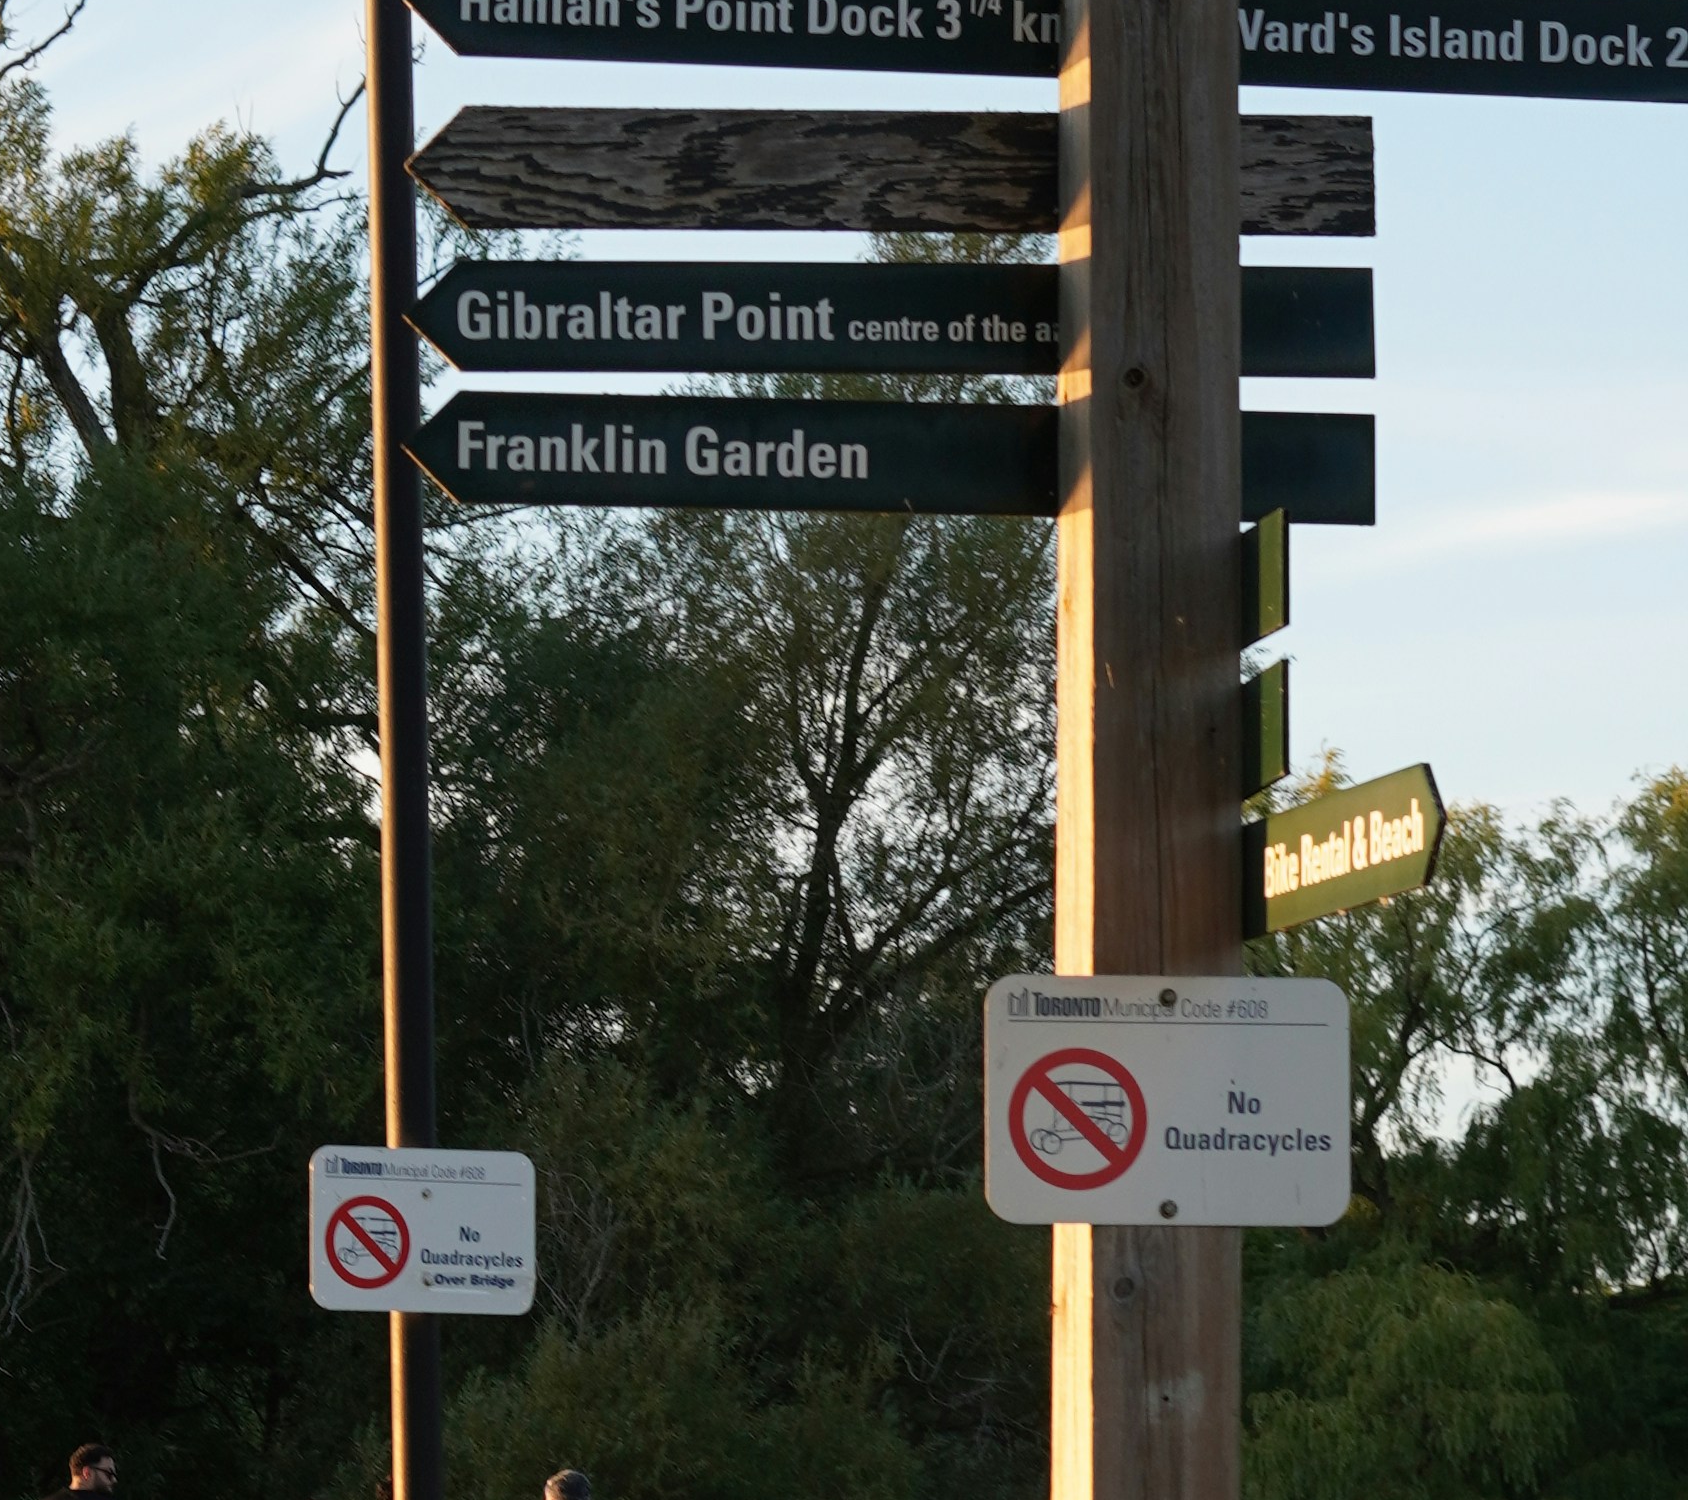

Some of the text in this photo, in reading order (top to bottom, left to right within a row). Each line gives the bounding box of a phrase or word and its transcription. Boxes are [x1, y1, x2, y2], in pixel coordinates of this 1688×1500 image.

[1389, 14, 1525, 62] Island
[1539, 20, 1653, 67] Dock
[457, 289, 686, 342] Gibraltar
[702, 292, 835, 342] Point
[848, 315, 941, 342] centre
[947, 314, 976, 342] of
[981, 314, 1028, 342] the
[457, 421, 869, 480] Franklin Garden
[1264, 798, 1424, 898] Bike Rental & Beach
[1032, 991, 1100, 1018] TORONTO
[1180, 998, 1222, 1019] Code
[1227, 1090, 1261, 1116] No
[1164, 1126, 1332, 1156] Quadracycles
[459, 1226, 480, 1242] No
[421, 1248, 523, 1270] Quadracycles
[434, 1273, 466, 1286] Over
